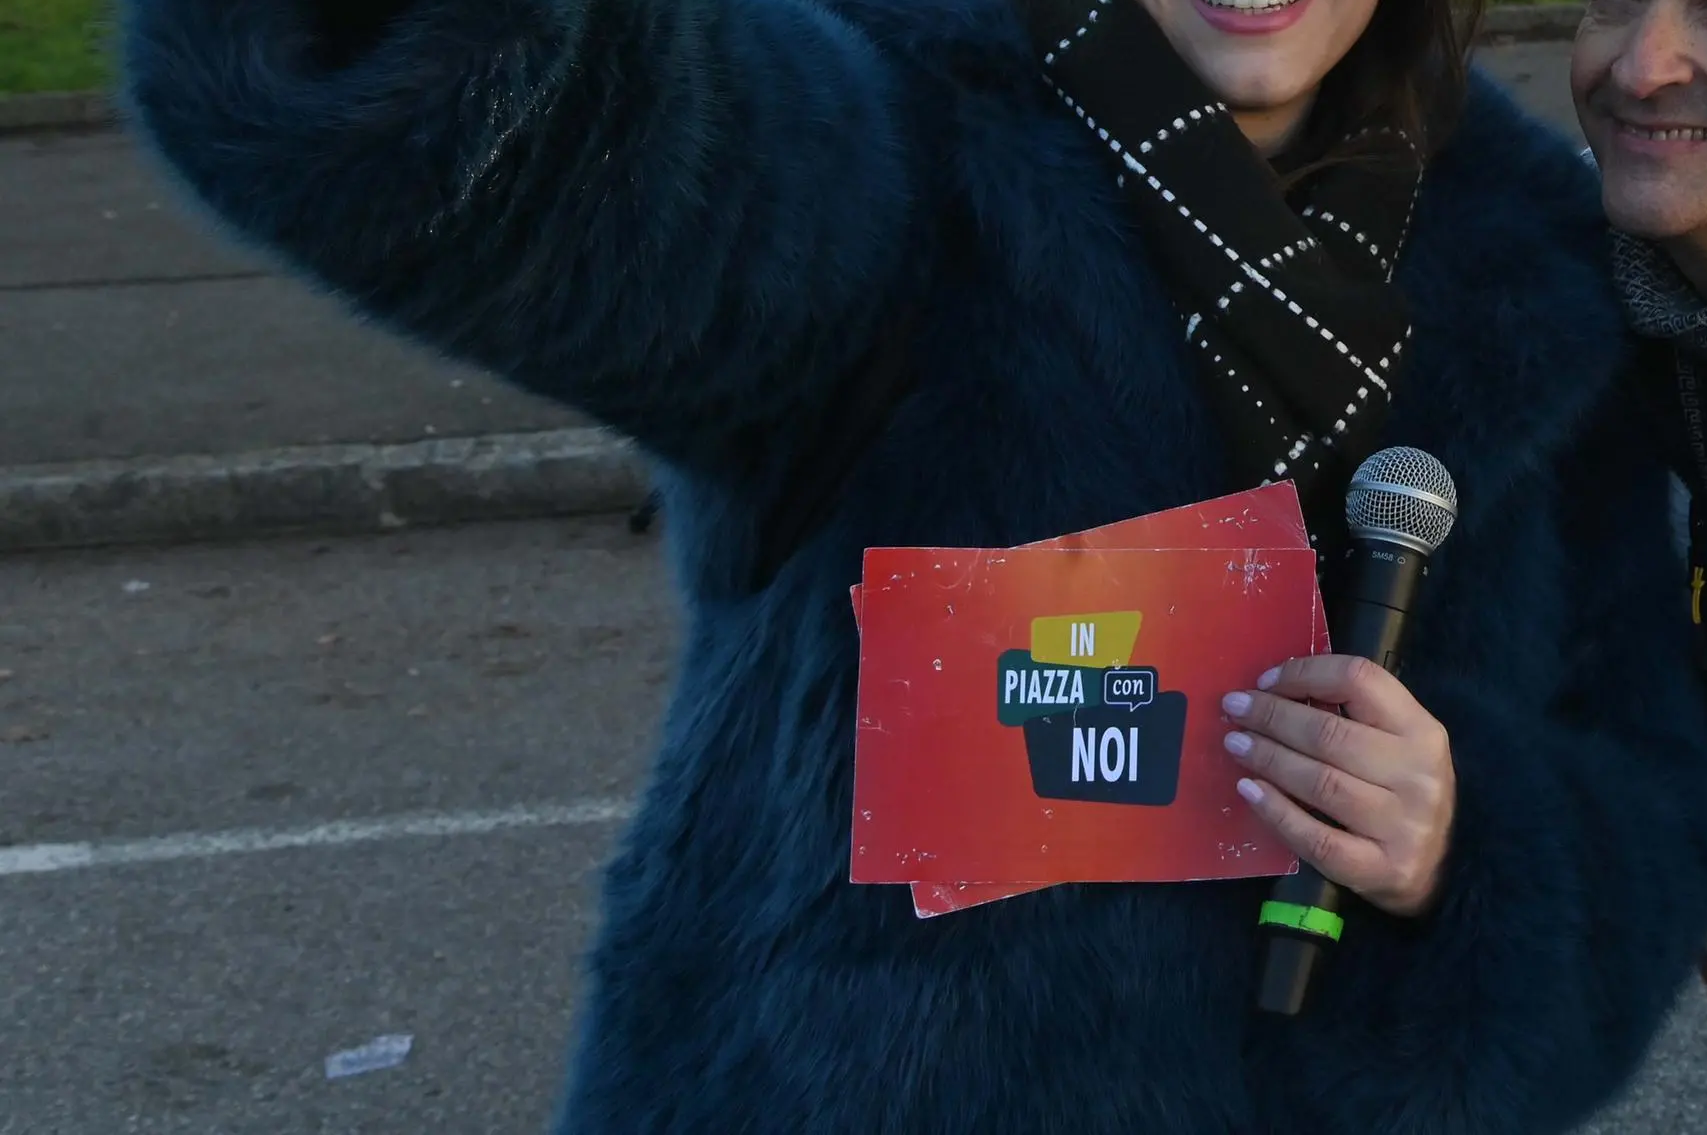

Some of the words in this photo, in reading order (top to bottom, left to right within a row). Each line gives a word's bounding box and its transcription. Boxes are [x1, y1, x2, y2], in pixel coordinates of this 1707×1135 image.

[1371, 550, 1394, 562] SM58
[1070, 622, 1095, 657] IN
[1004, 669, 1085, 704] PIAZZA
[1112, 678, 1145, 696] con
[1071, 726, 1139, 783] NOI
